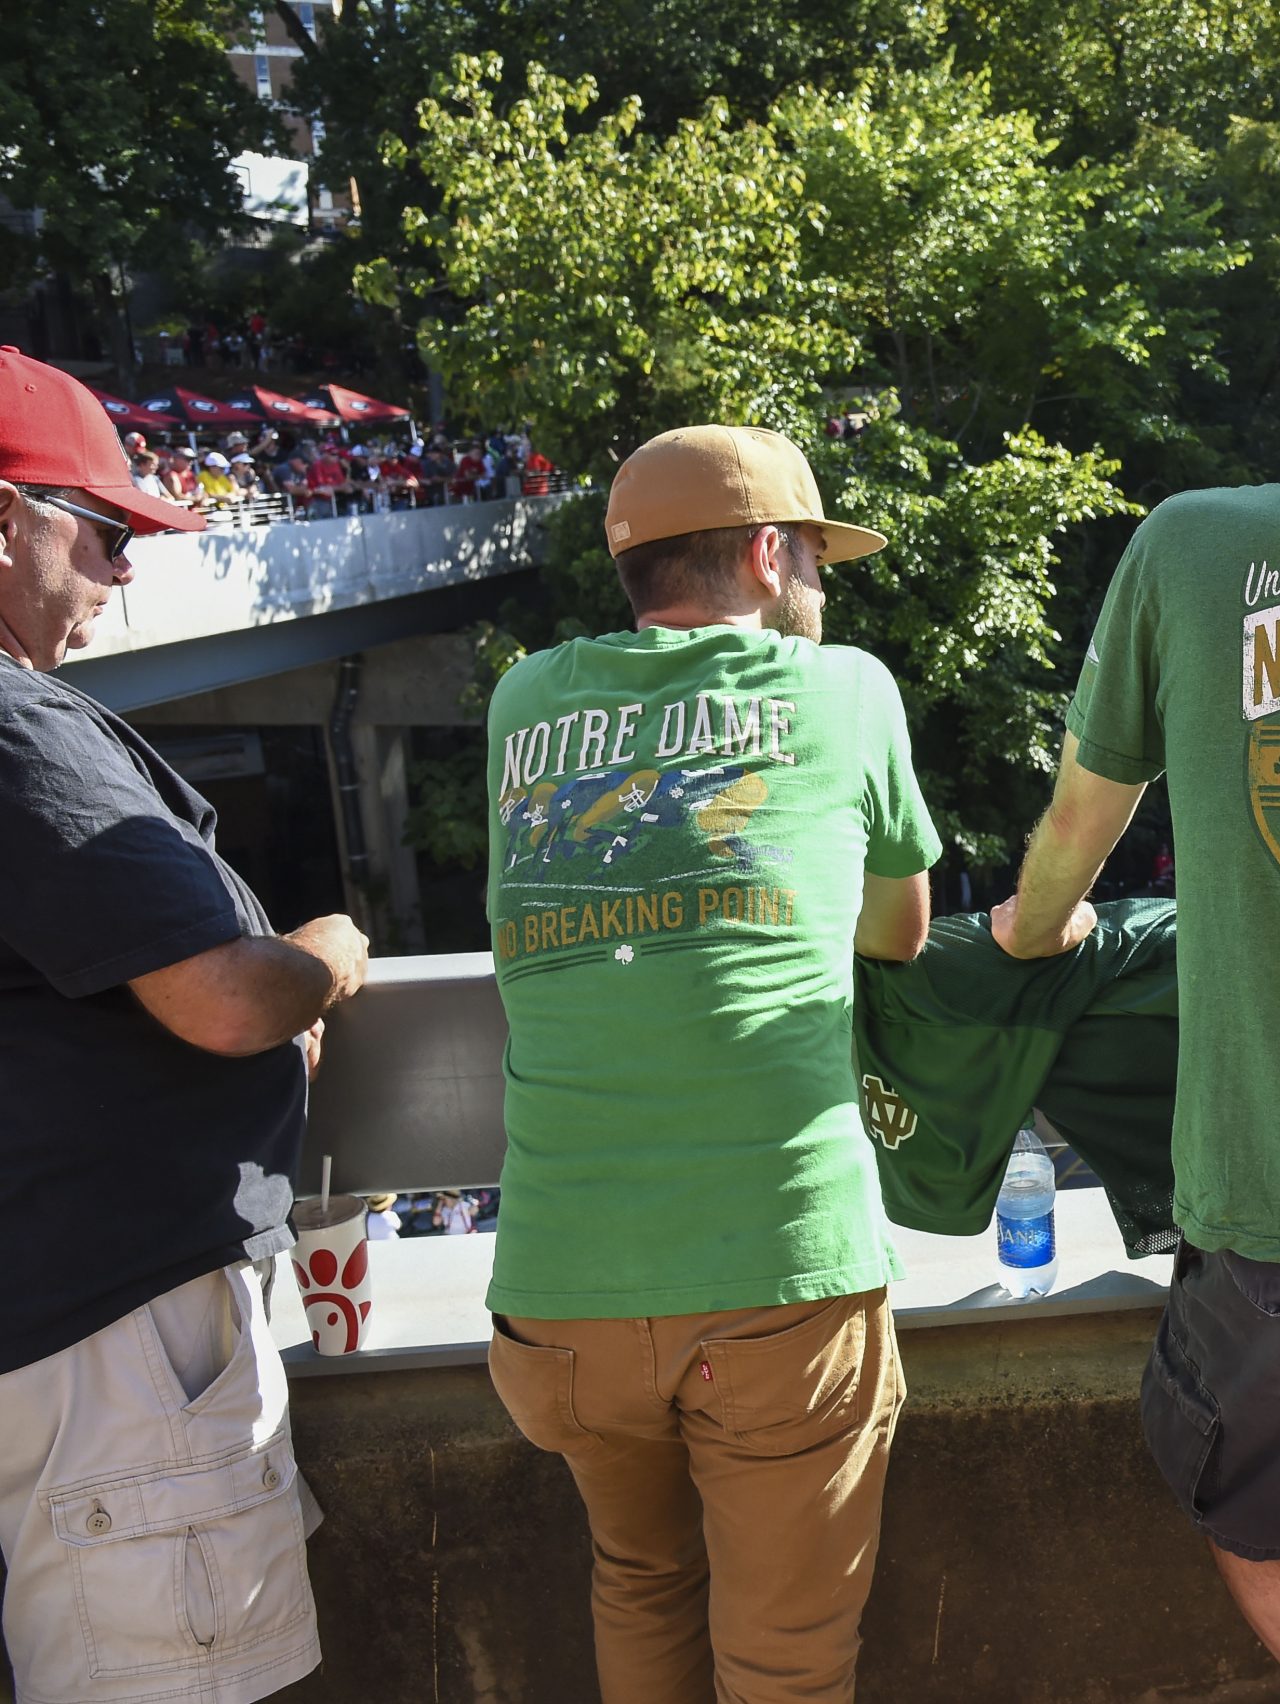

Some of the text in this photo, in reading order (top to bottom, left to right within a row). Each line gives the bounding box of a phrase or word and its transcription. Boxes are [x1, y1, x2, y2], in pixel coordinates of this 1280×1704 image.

[498, 694, 797, 802] NOTRE DAME
[523, 891, 685, 954] BREAKING
[699, 886, 798, 928] POINT
